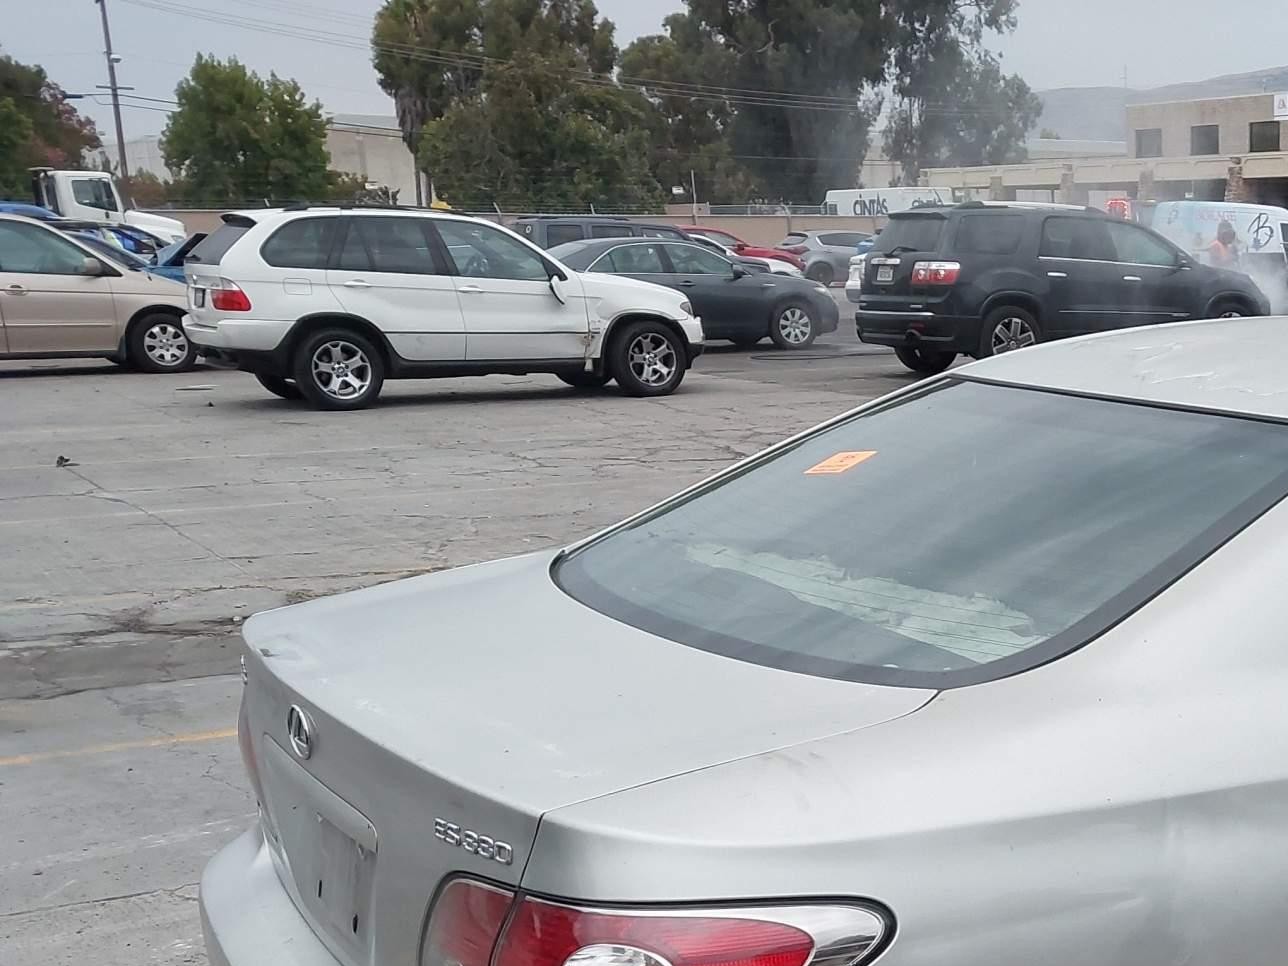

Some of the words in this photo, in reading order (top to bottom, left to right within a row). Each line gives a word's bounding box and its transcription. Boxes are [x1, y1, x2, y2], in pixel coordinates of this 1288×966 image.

[853, 193, 888, 215] CINTAS
[434, 817, 461, 846] ES
[462, 829, 513, 865] 330
